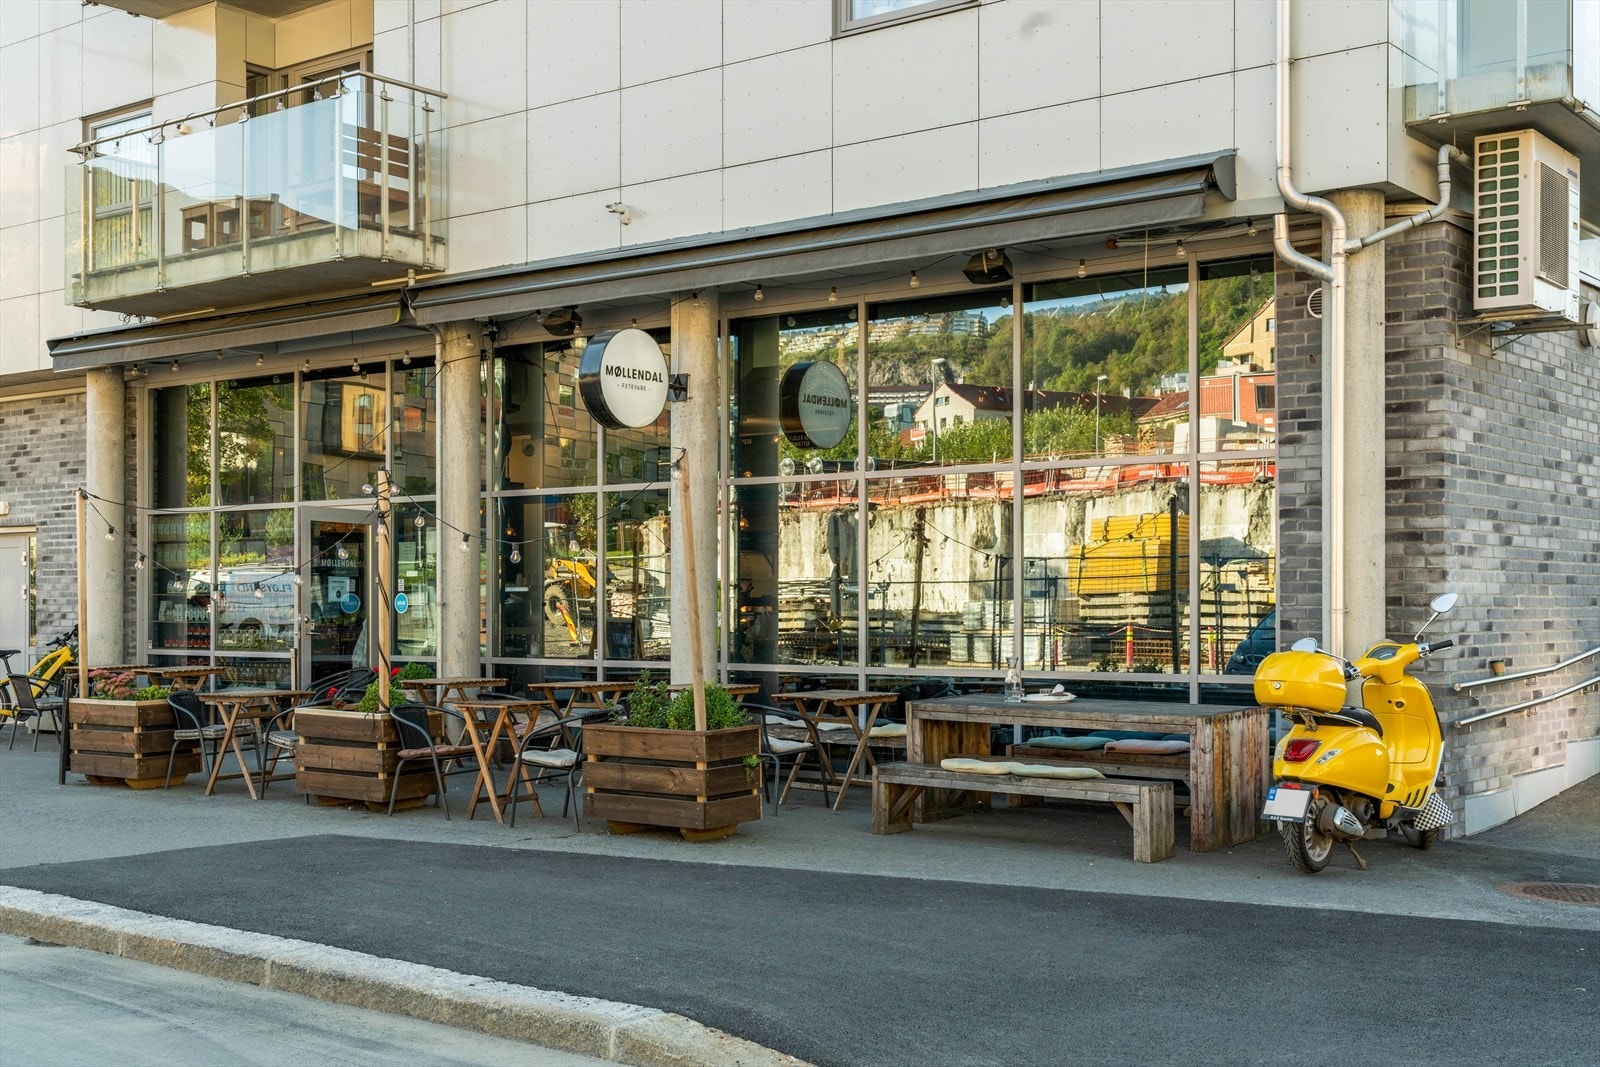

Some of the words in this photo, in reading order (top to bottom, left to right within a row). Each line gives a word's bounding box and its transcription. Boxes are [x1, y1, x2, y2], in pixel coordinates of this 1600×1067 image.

[605, 364, 664, 383] MØLLENDAL
[621, 382, 647, 392] FETEVARE
[321, 558, 357, 568] MØLLENDAL
